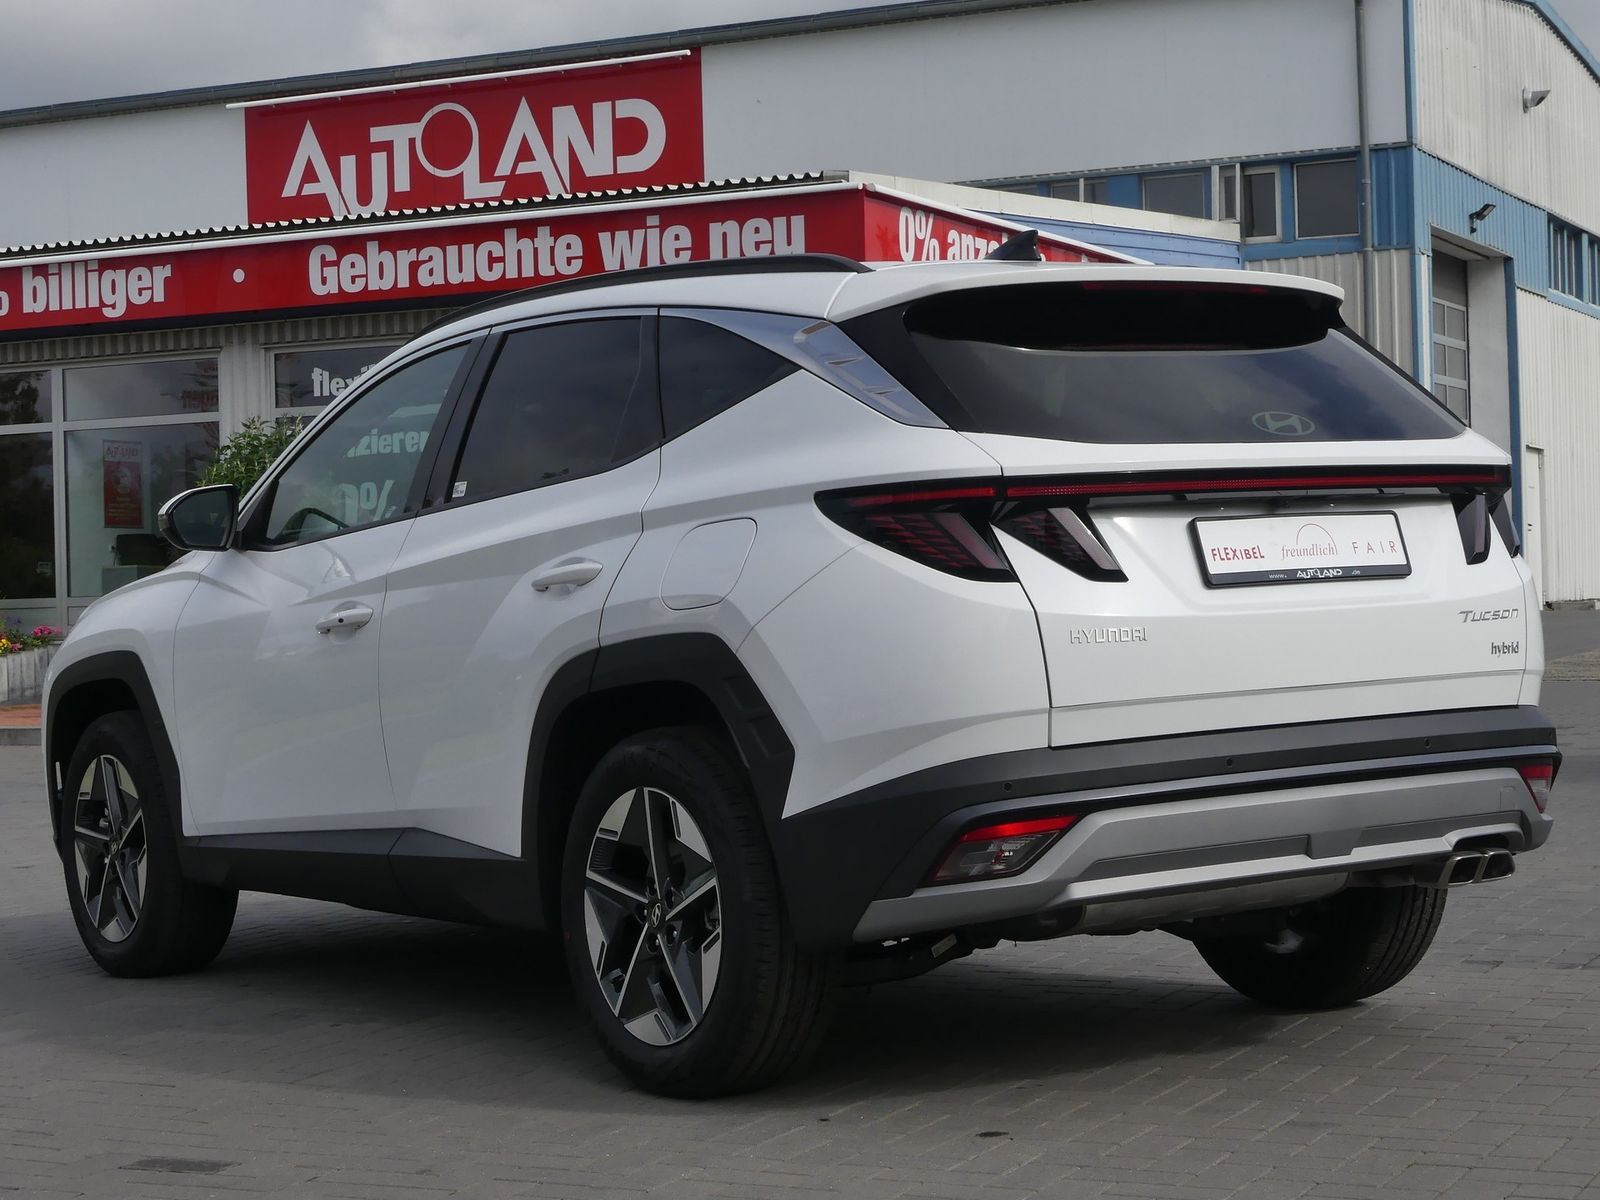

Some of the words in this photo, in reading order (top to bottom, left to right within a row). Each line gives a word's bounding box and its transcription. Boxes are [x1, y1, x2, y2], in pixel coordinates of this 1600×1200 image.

[281, 96, 667, 216] AUTOLAND
[899, 207, 940, 262] 0%
[308, 226, 584, 296] Gebrauchte
[598, 215, 692, 271] wie
[709, 215, 806, 260] neu
[22, 260, 172, 318] billiger
[1211, 545, 1264, 561] FLEXIBEL
[1281, 543, 1335, 560] freundlich
[1352, 540, 1397, 554] FAIR
[1296, 568, 1342, 579] AUTOLAND
[1069, 627, 1148, 644] HYUNDAI
[1491, 641, 1519, 658] hybrid
